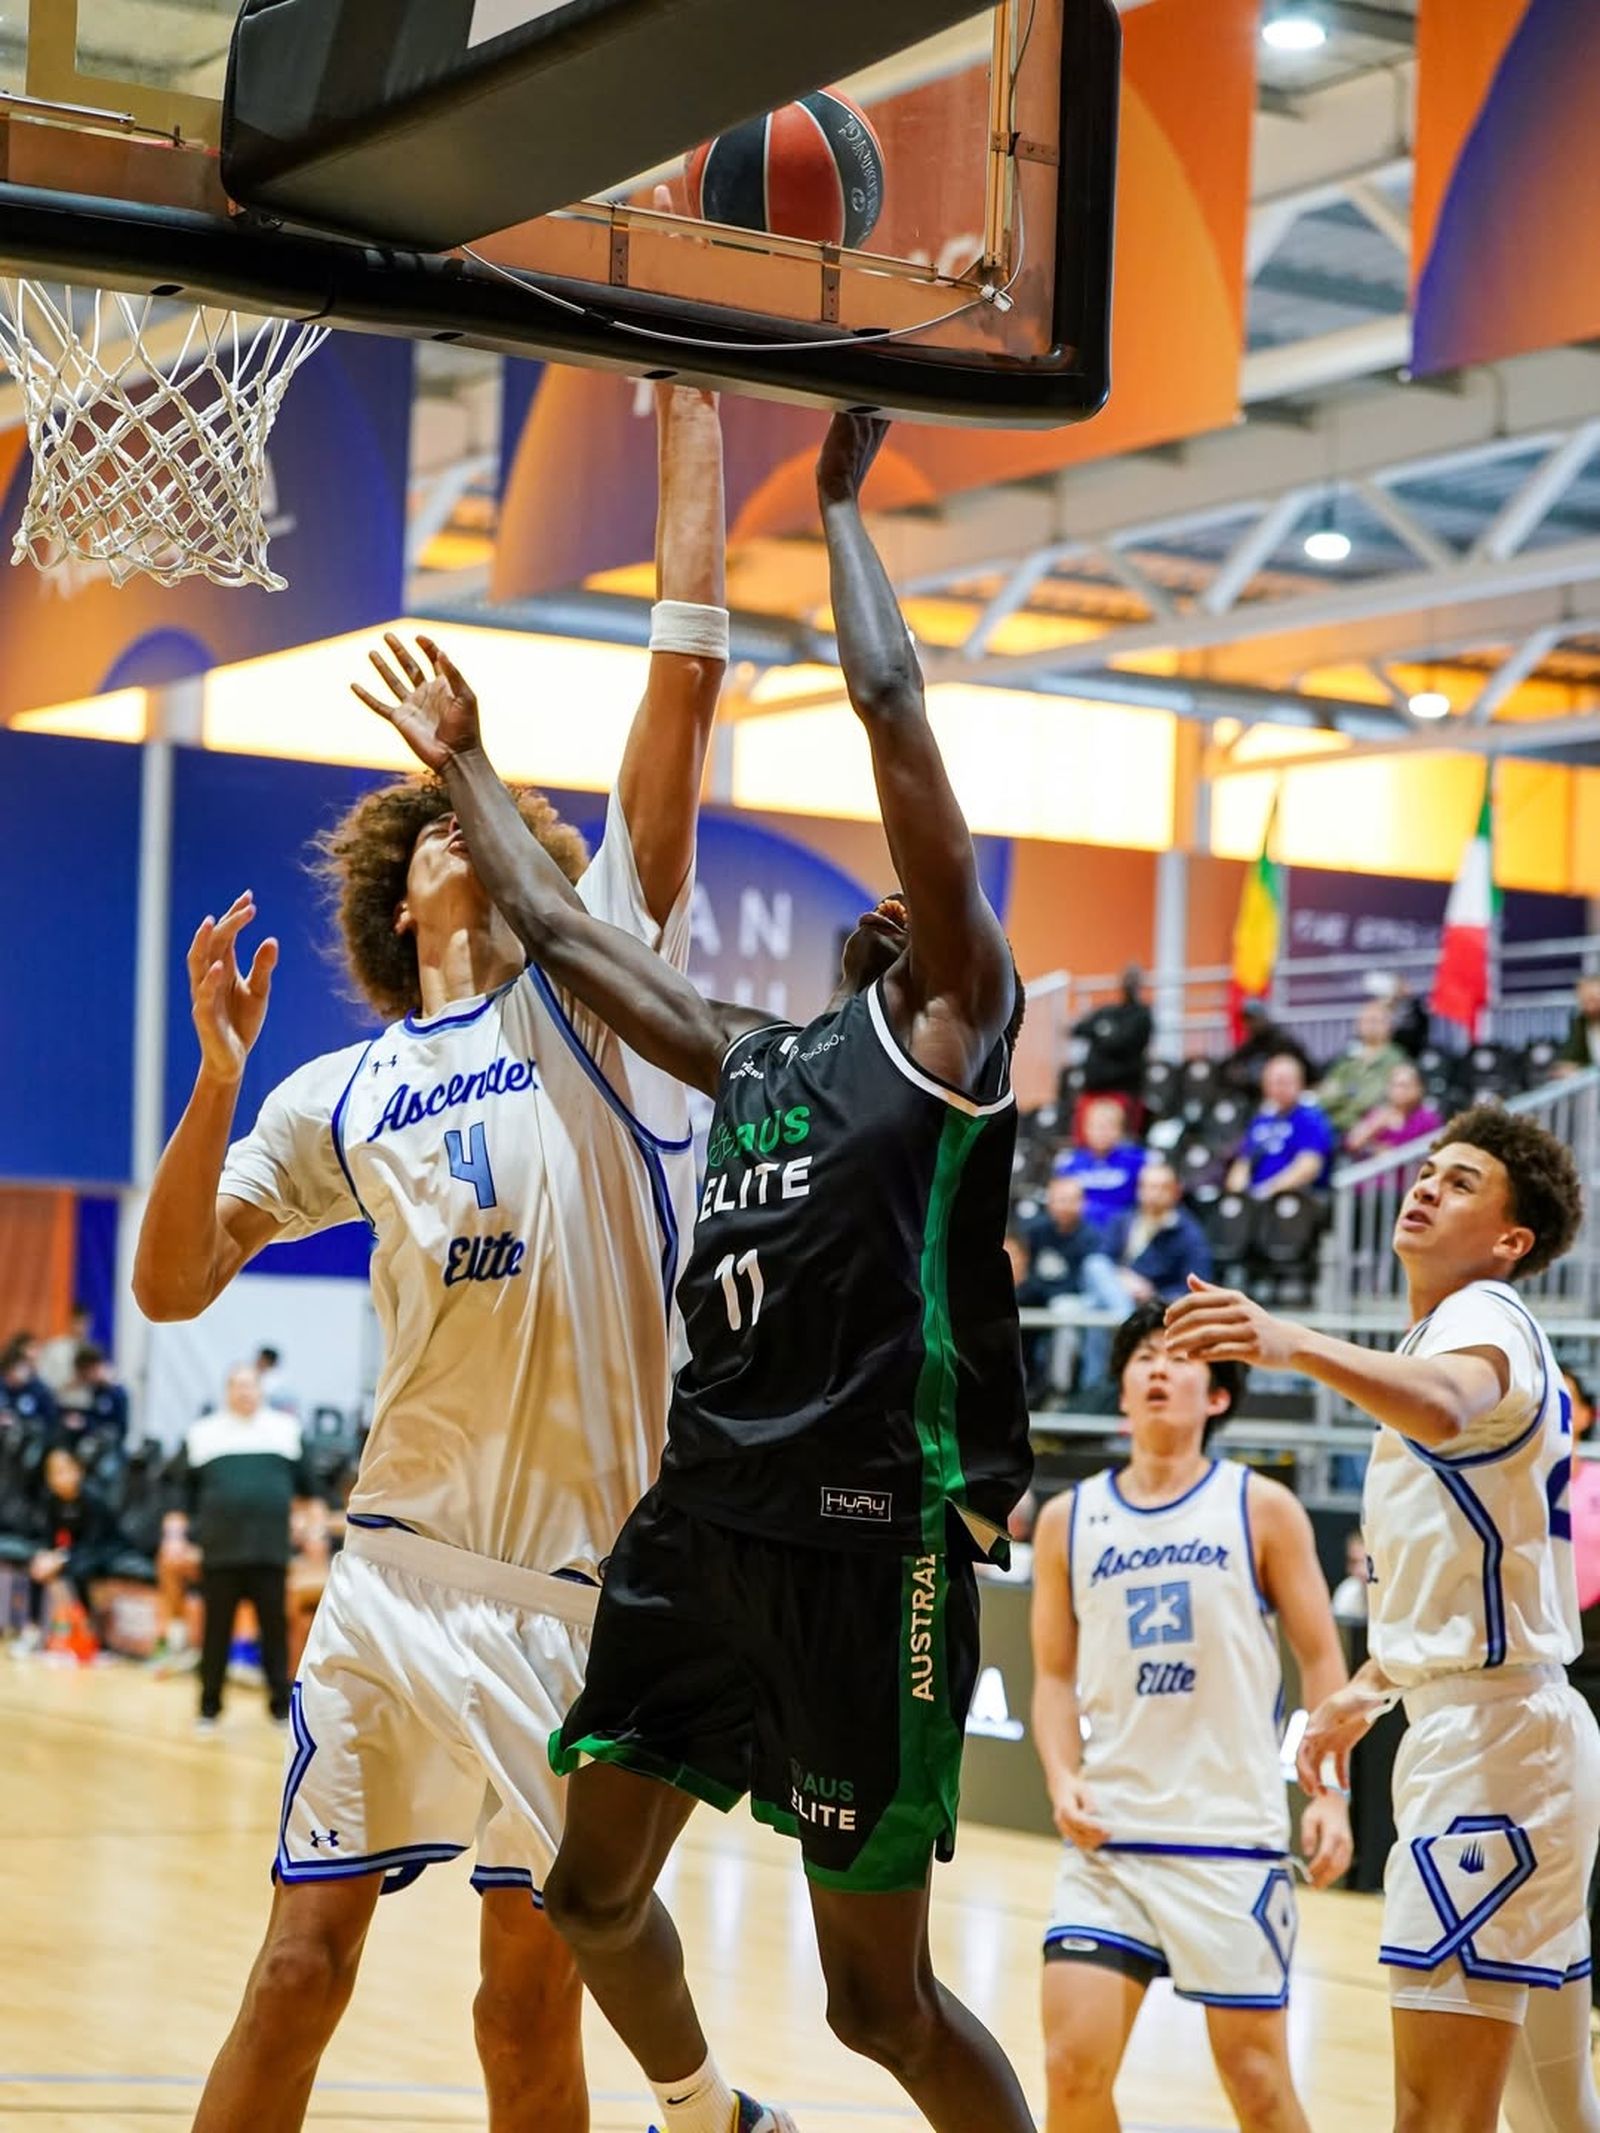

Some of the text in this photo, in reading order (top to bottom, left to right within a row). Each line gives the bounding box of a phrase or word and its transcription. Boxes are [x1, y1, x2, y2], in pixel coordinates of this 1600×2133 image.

[444, 1121, 498, 1210] 4
[698, 1156, 813, 1223] ELITE
[443, 1231, 527, 1287] Elite
[713, 1248, 765, 1331] 11
[1089, 1537, 1229, 1588] Ascender
[1126, 1580, 1195, 1650] 23
[1136, 1660, 1197, 1696] Elite
